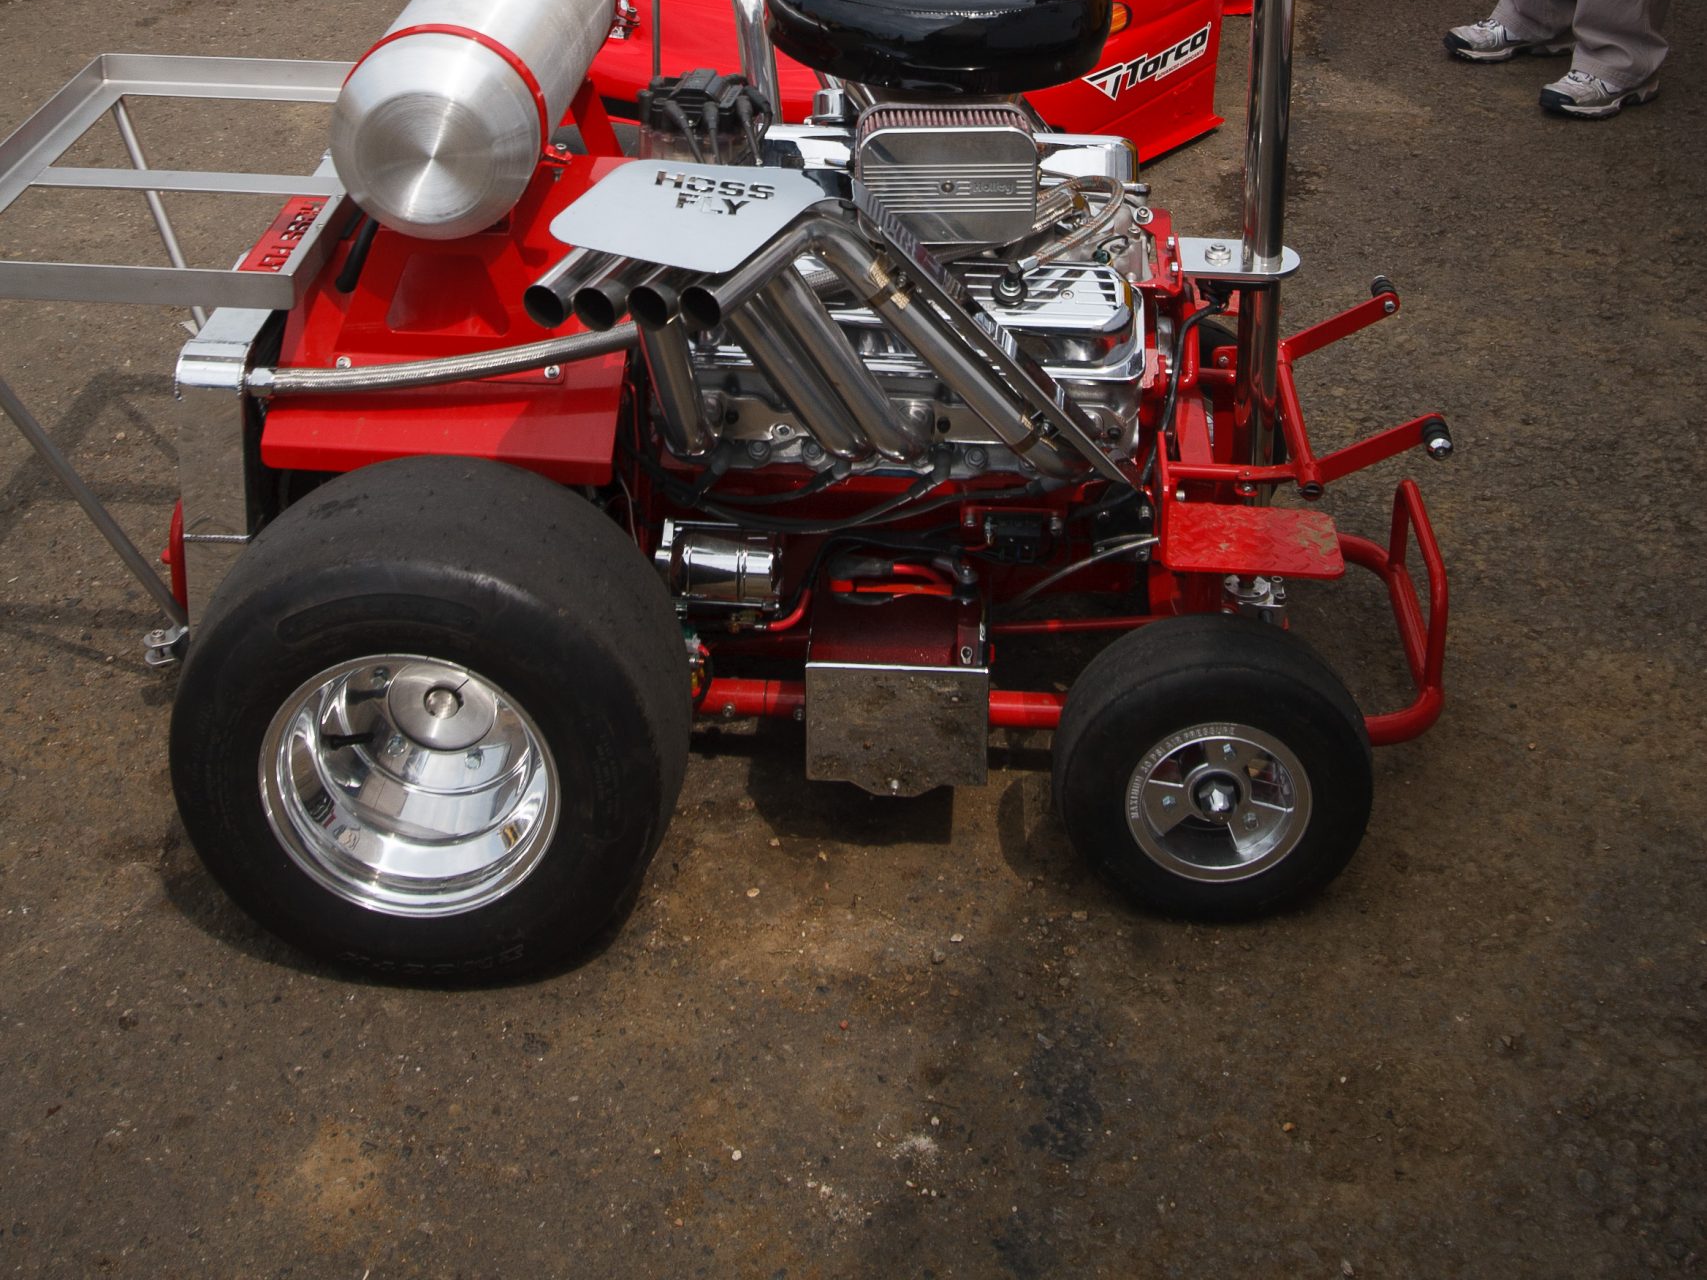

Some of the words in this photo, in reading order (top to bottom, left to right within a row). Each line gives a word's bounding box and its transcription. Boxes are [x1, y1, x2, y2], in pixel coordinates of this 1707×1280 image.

[1125, 27, 1208, 88] Torco
[655, 170, 776, 200] HOSS
[972, 181, 1014, 195] Holley
[675, 192, 751, 215] FLY
